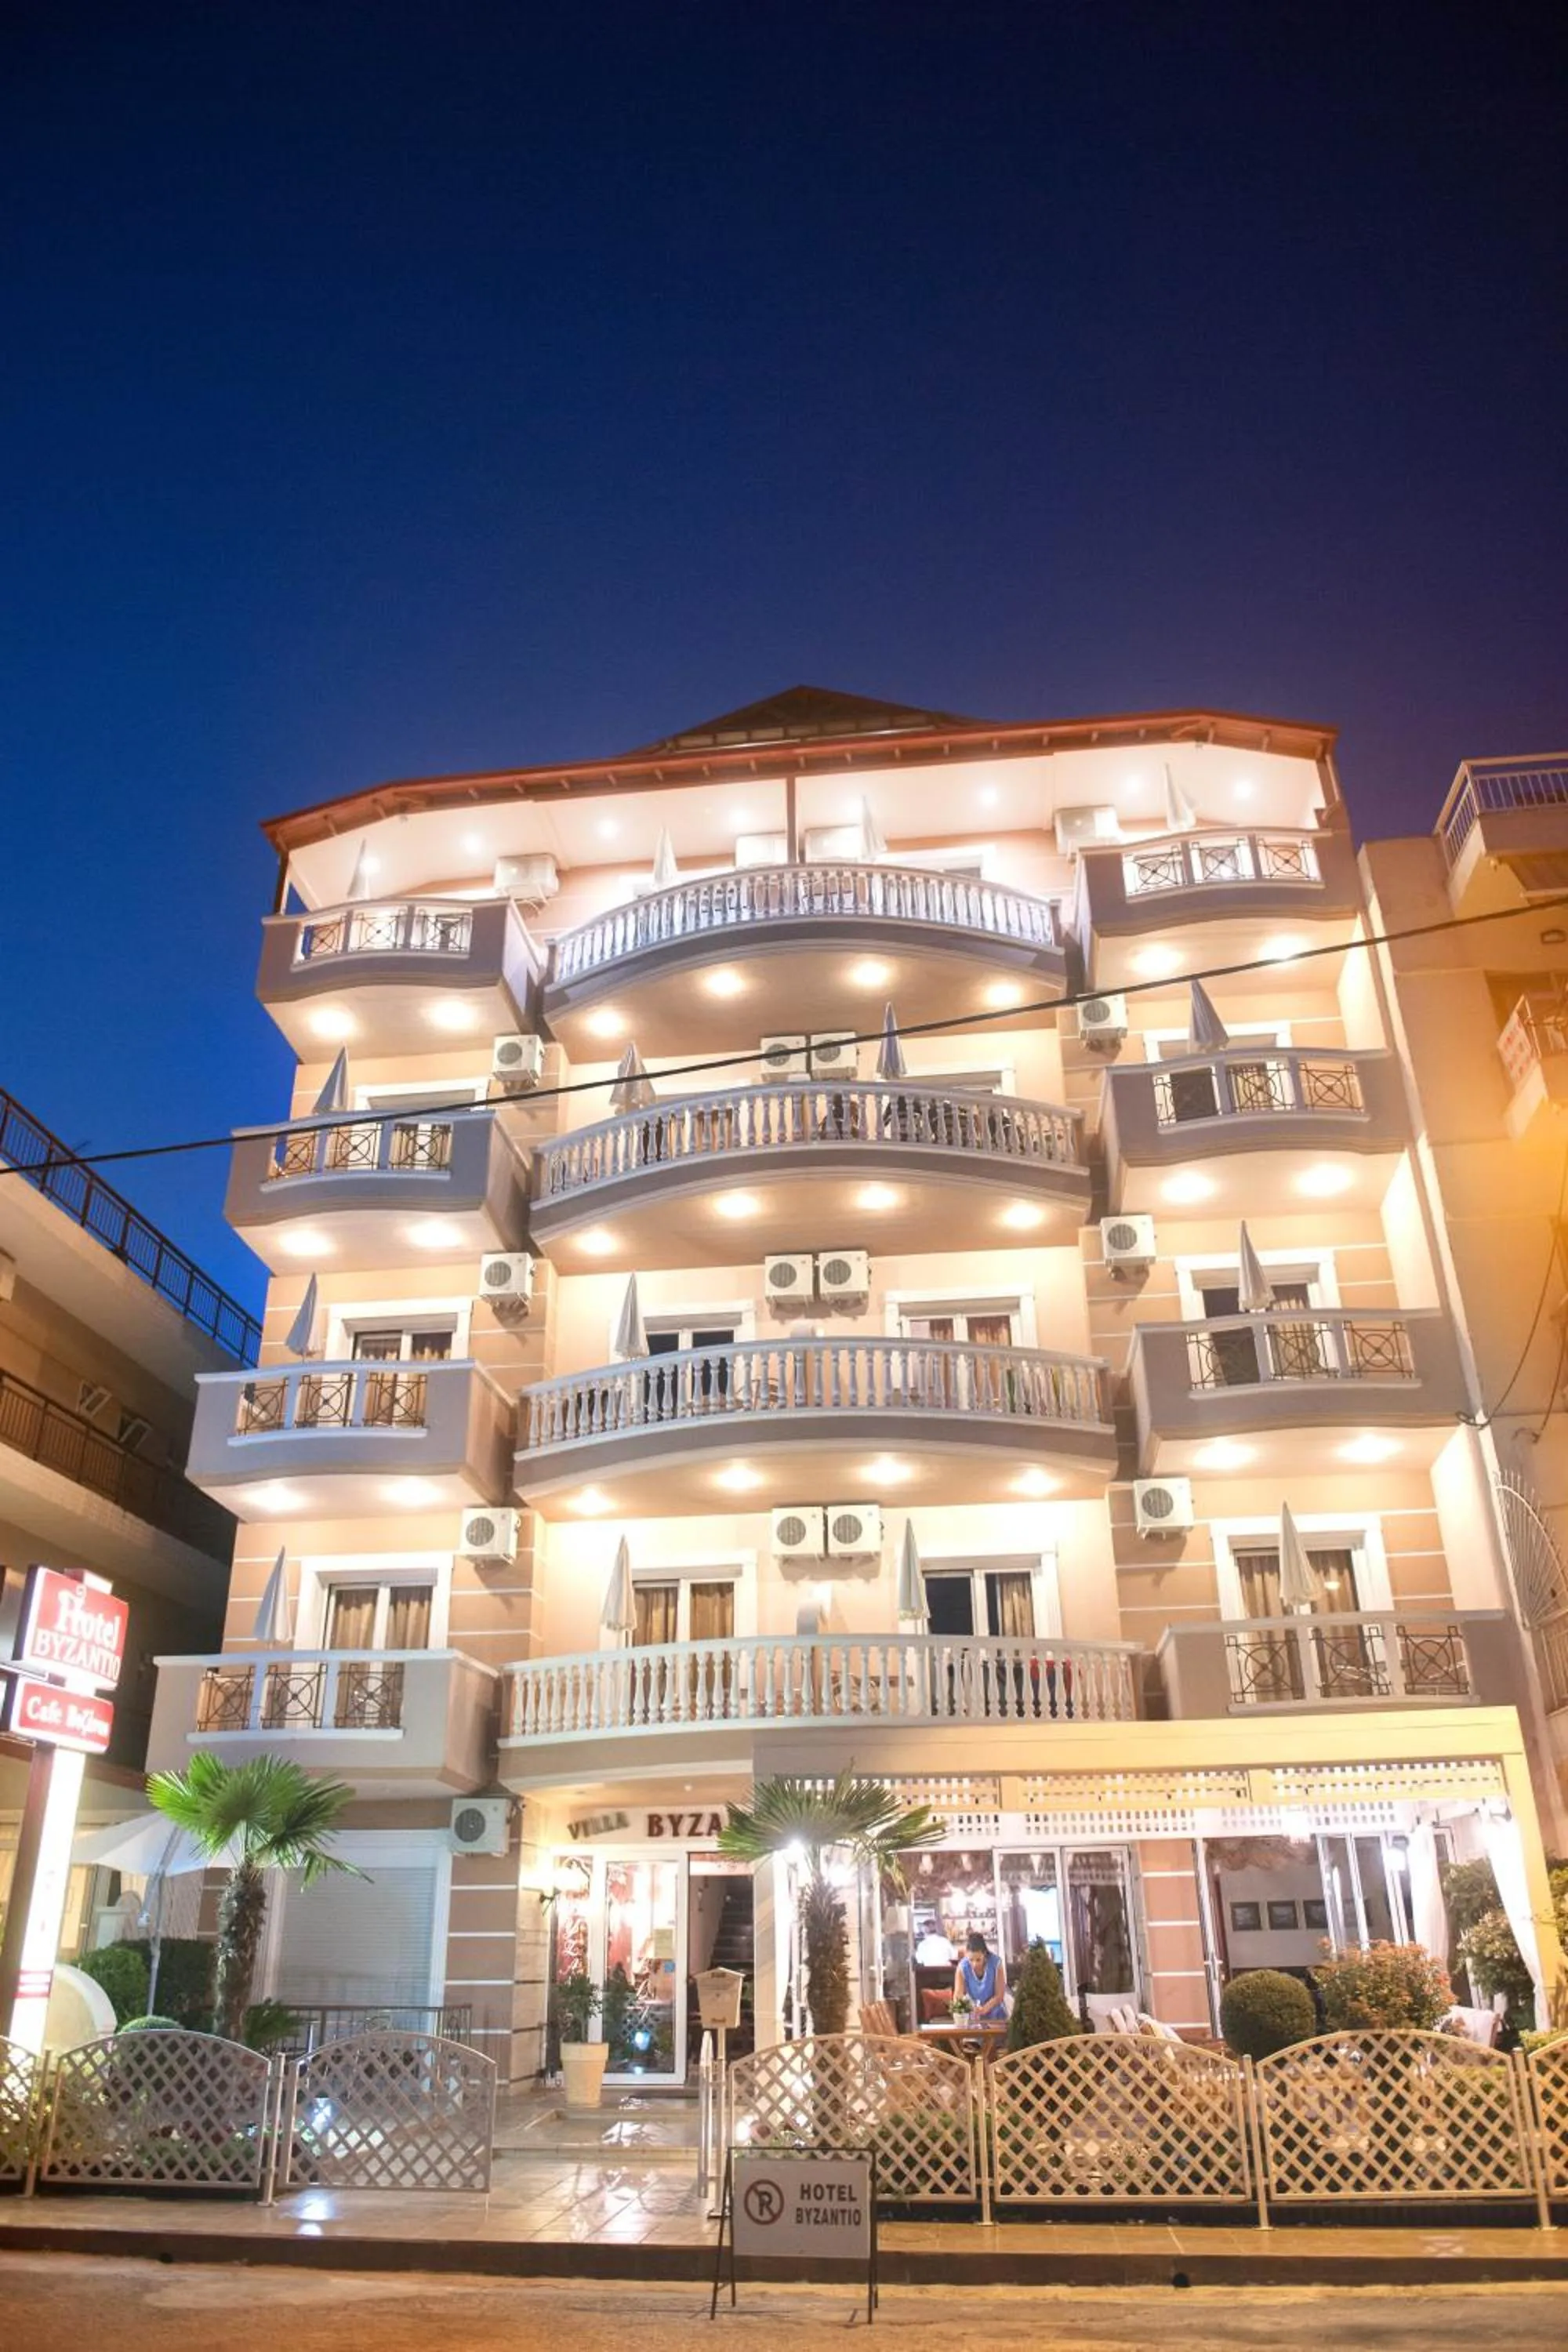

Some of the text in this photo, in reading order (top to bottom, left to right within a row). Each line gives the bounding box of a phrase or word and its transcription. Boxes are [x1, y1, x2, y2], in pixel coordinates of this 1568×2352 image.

[55, 1584, 122, 1651] Hotel
[34, 1628, 121, 1681] BYZANTIO
[800, 2183, 858, 2202] HOTEL
[795, 2207, 862, 2227] BYZANTIO
